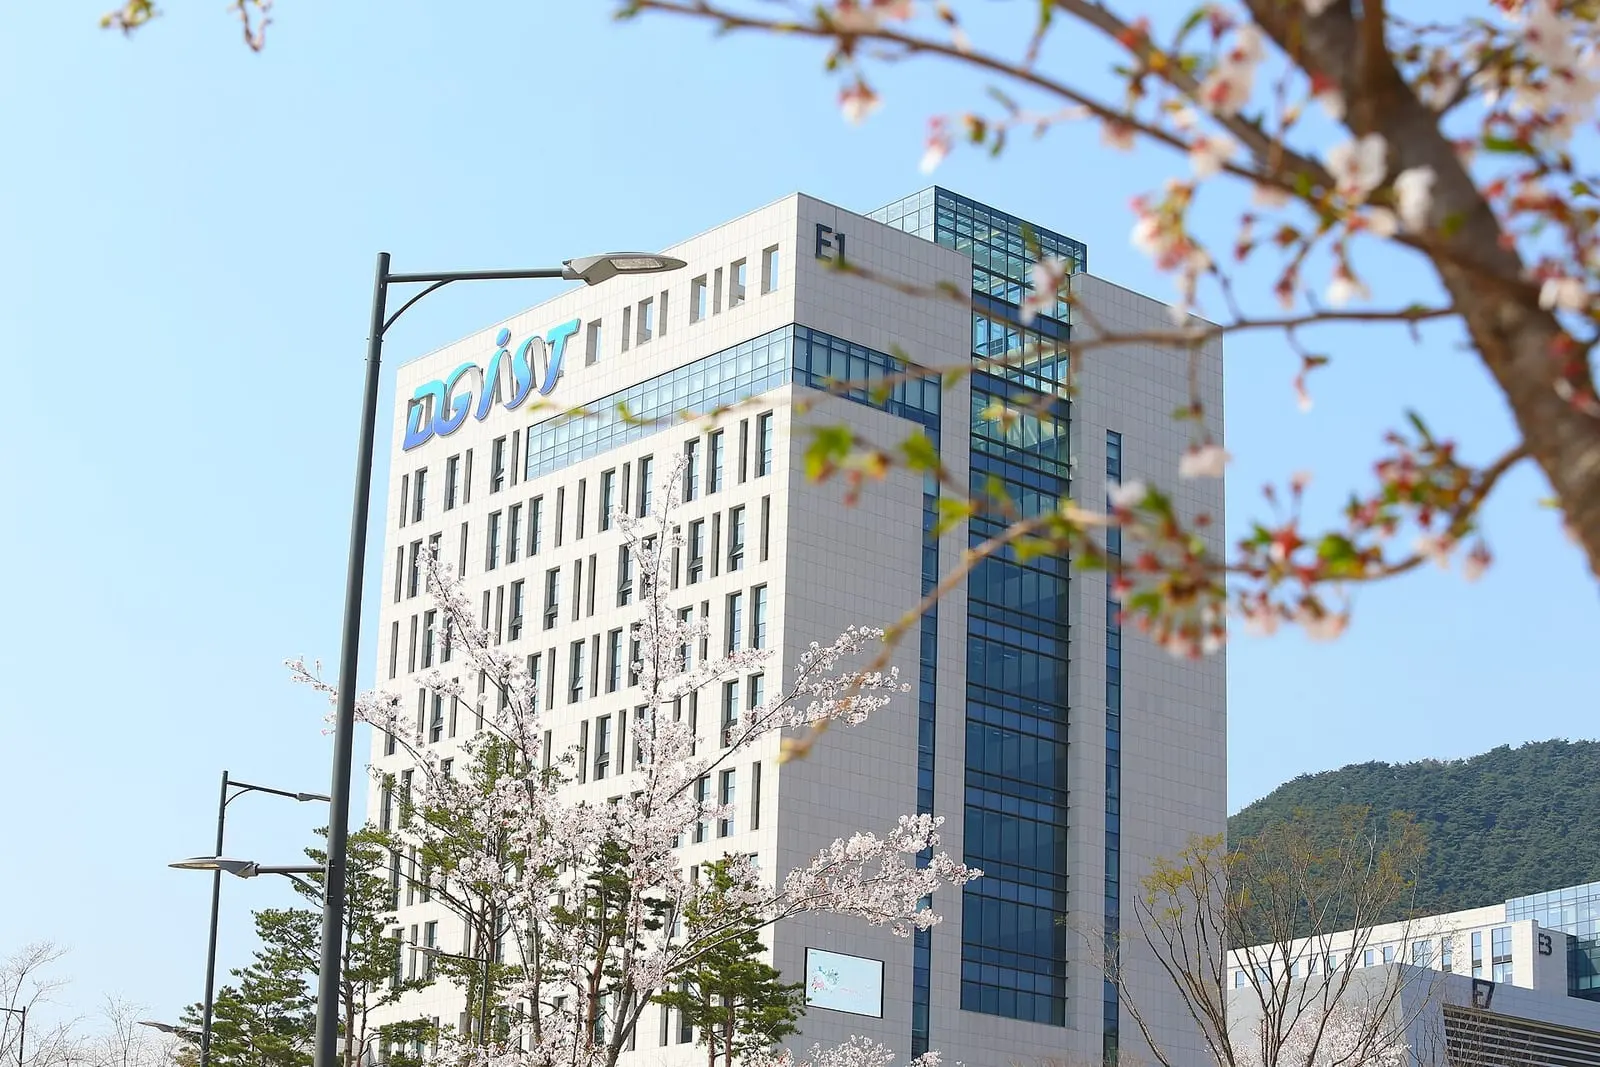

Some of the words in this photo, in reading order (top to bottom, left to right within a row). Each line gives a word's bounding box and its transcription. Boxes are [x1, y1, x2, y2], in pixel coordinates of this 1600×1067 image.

[815, 223, 845, 265] E1
[1538, 932, 1553, 956] E3
[1472, 978, 1495, 1009] E7
